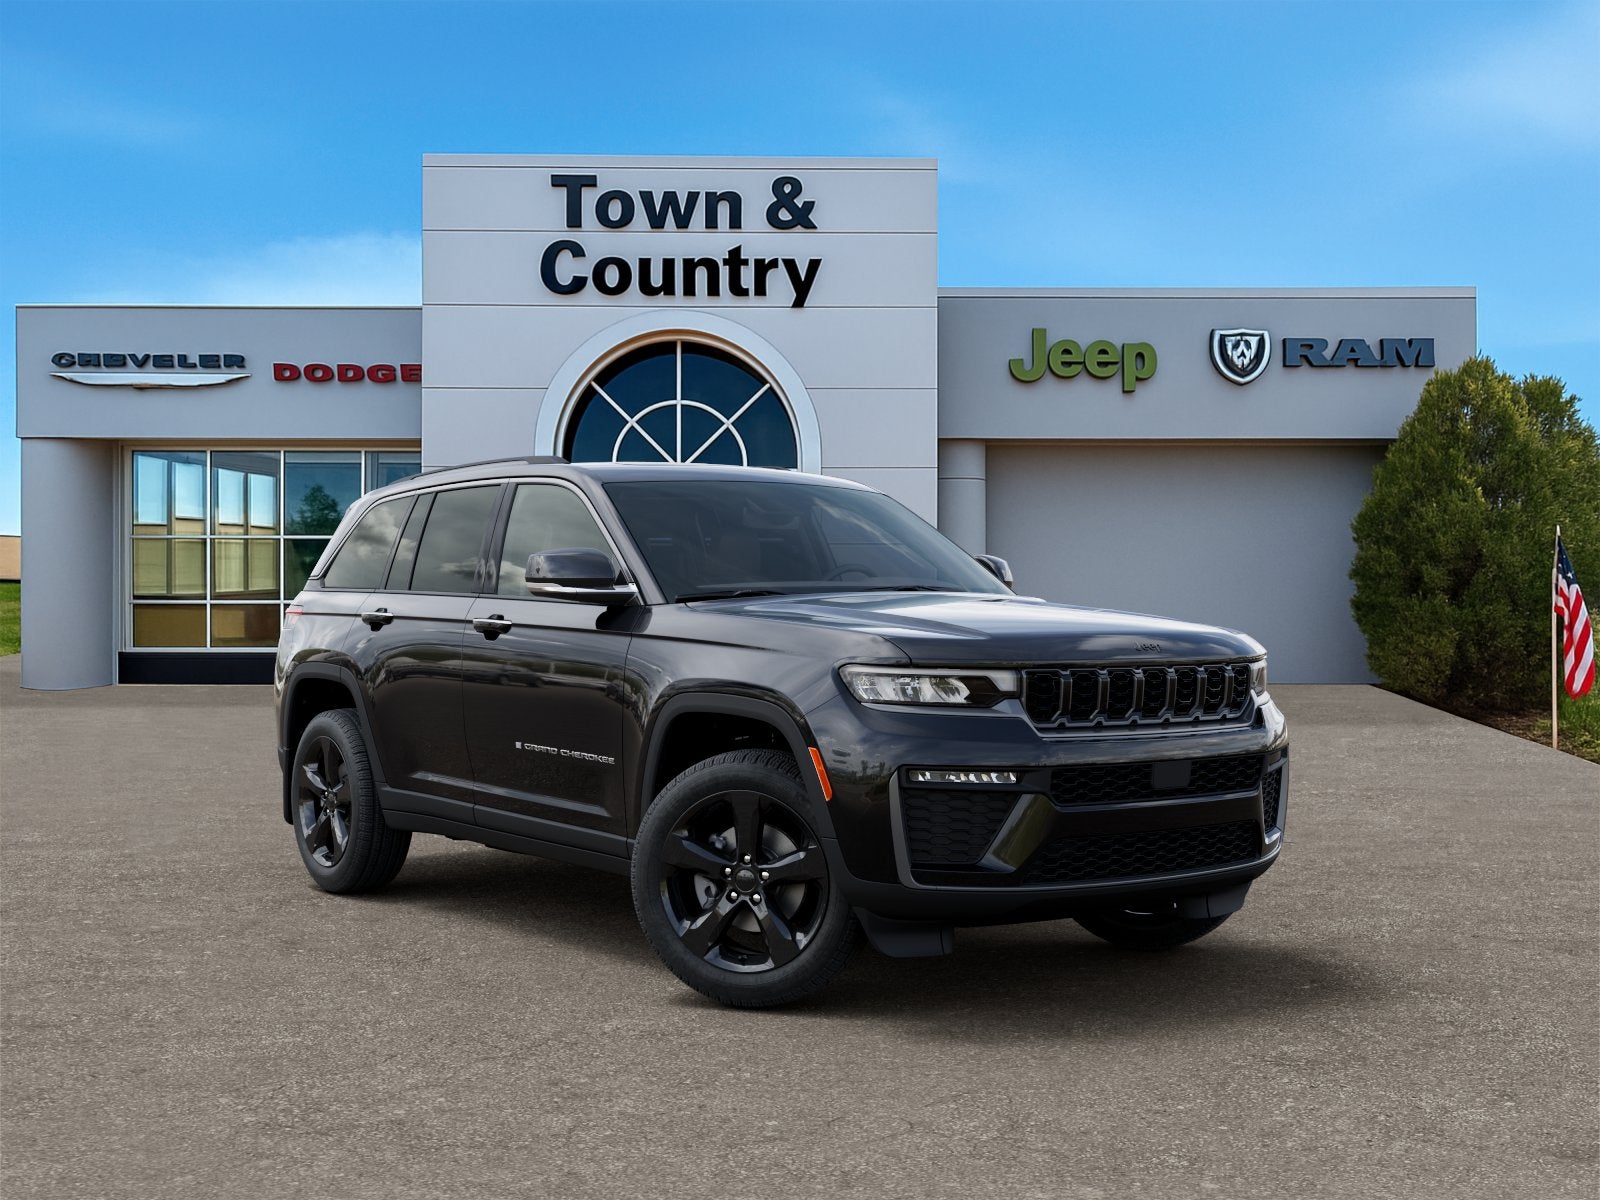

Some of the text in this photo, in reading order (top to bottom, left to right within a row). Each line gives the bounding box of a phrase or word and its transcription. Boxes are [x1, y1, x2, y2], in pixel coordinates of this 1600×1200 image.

[550, 174, 818, 230] Town &
[540, 239, 822, 308] Country
[273, 362, 422, 383] DODGE
[1009, 327, 1158, 393] Jeep
[1282, 337, 1436, 368] RAM
[524, 743, 615, 764] GRAND CHEROKEE
